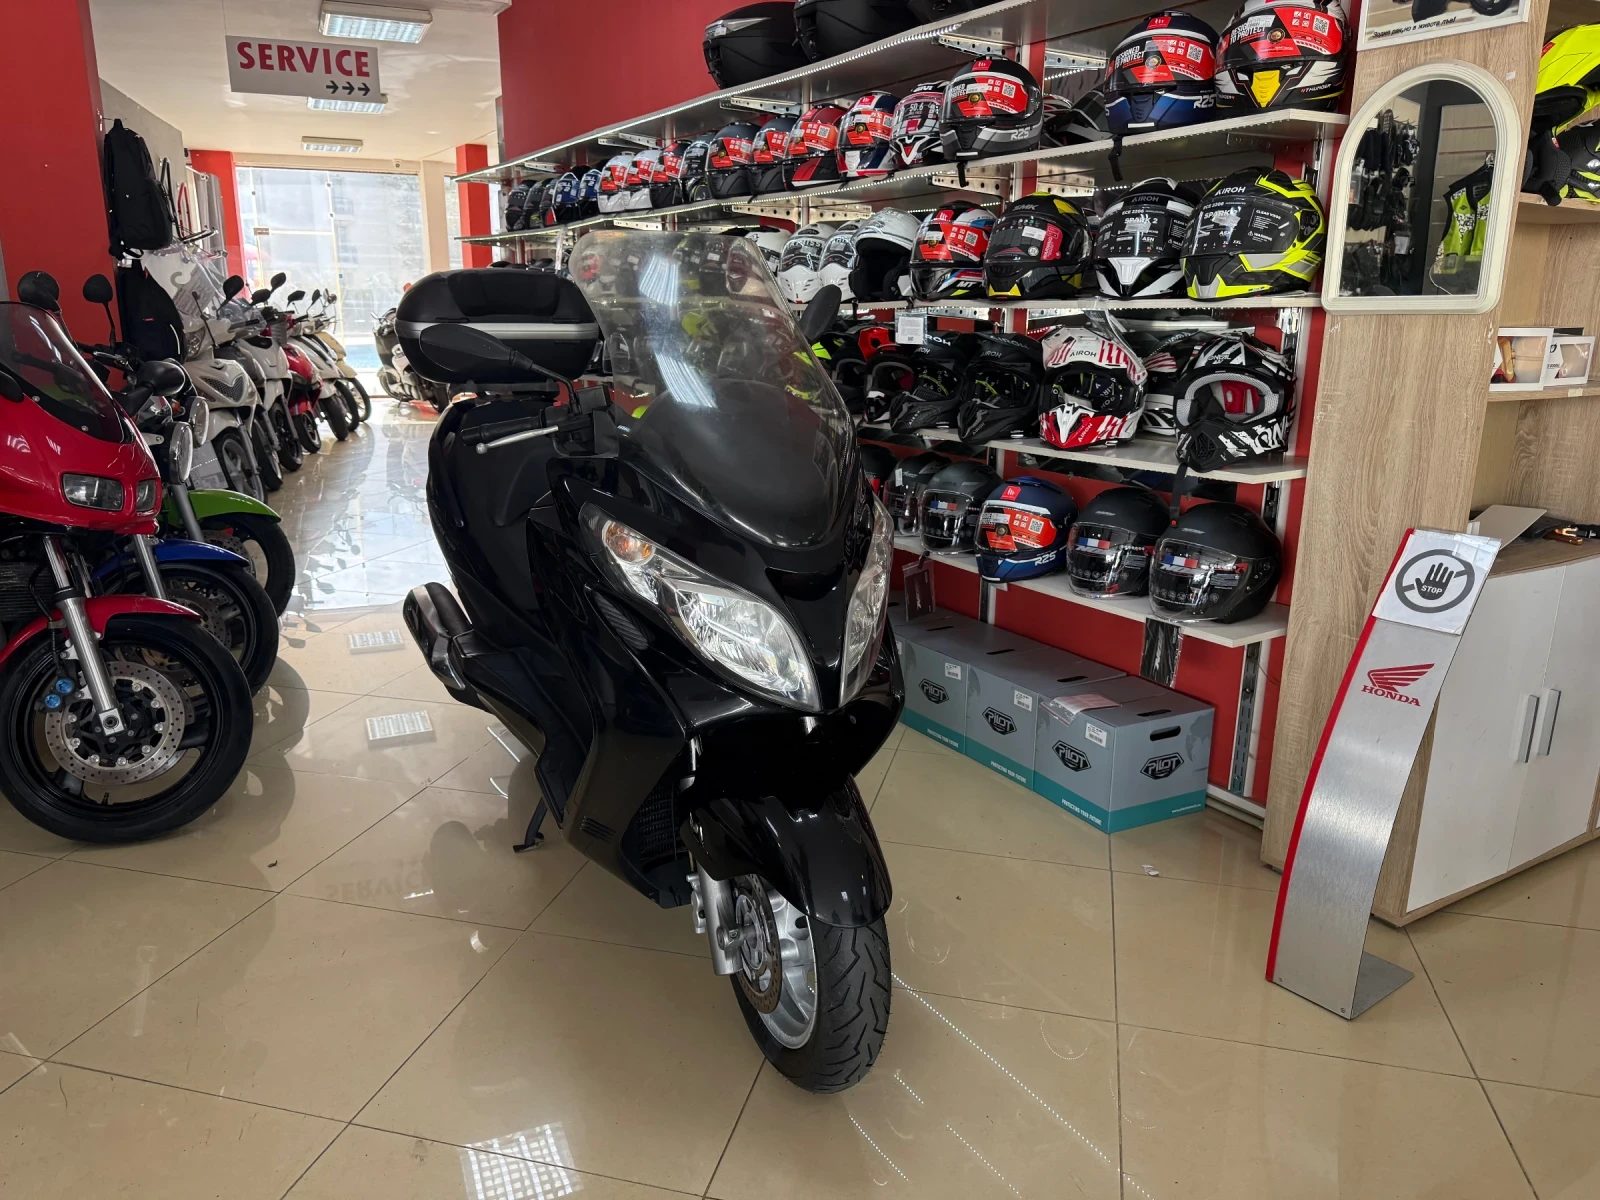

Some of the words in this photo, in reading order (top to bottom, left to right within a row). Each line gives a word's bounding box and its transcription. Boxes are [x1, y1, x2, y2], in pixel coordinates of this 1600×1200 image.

[1236, 26, 1265, 40] PROTECT
[236, 41, 371, 78] SERVICE
[1116, 45, 1140, 61] DESIGNED
[1119, 51, 1145, 65] PROTECT
[1215, 186, 1246, 196] AIROH
[1131, 195, 1160, 203] AIROH
[1124, 217, 1152, 225] SPARK
[1152, 217, 1159, 225] 2
[958, 280, 975, 288] MT
[1069, 350, 1097, 358] AIROH
[1077, 422, 1093, 443] AIROH
[1420, 584, 1443, 595] STOP
[1361, 684, 1421, 706] HONDA
[1061, 798, 1081, 814] PROTECTING
[1080, 809, 1090, 819] YOUR
